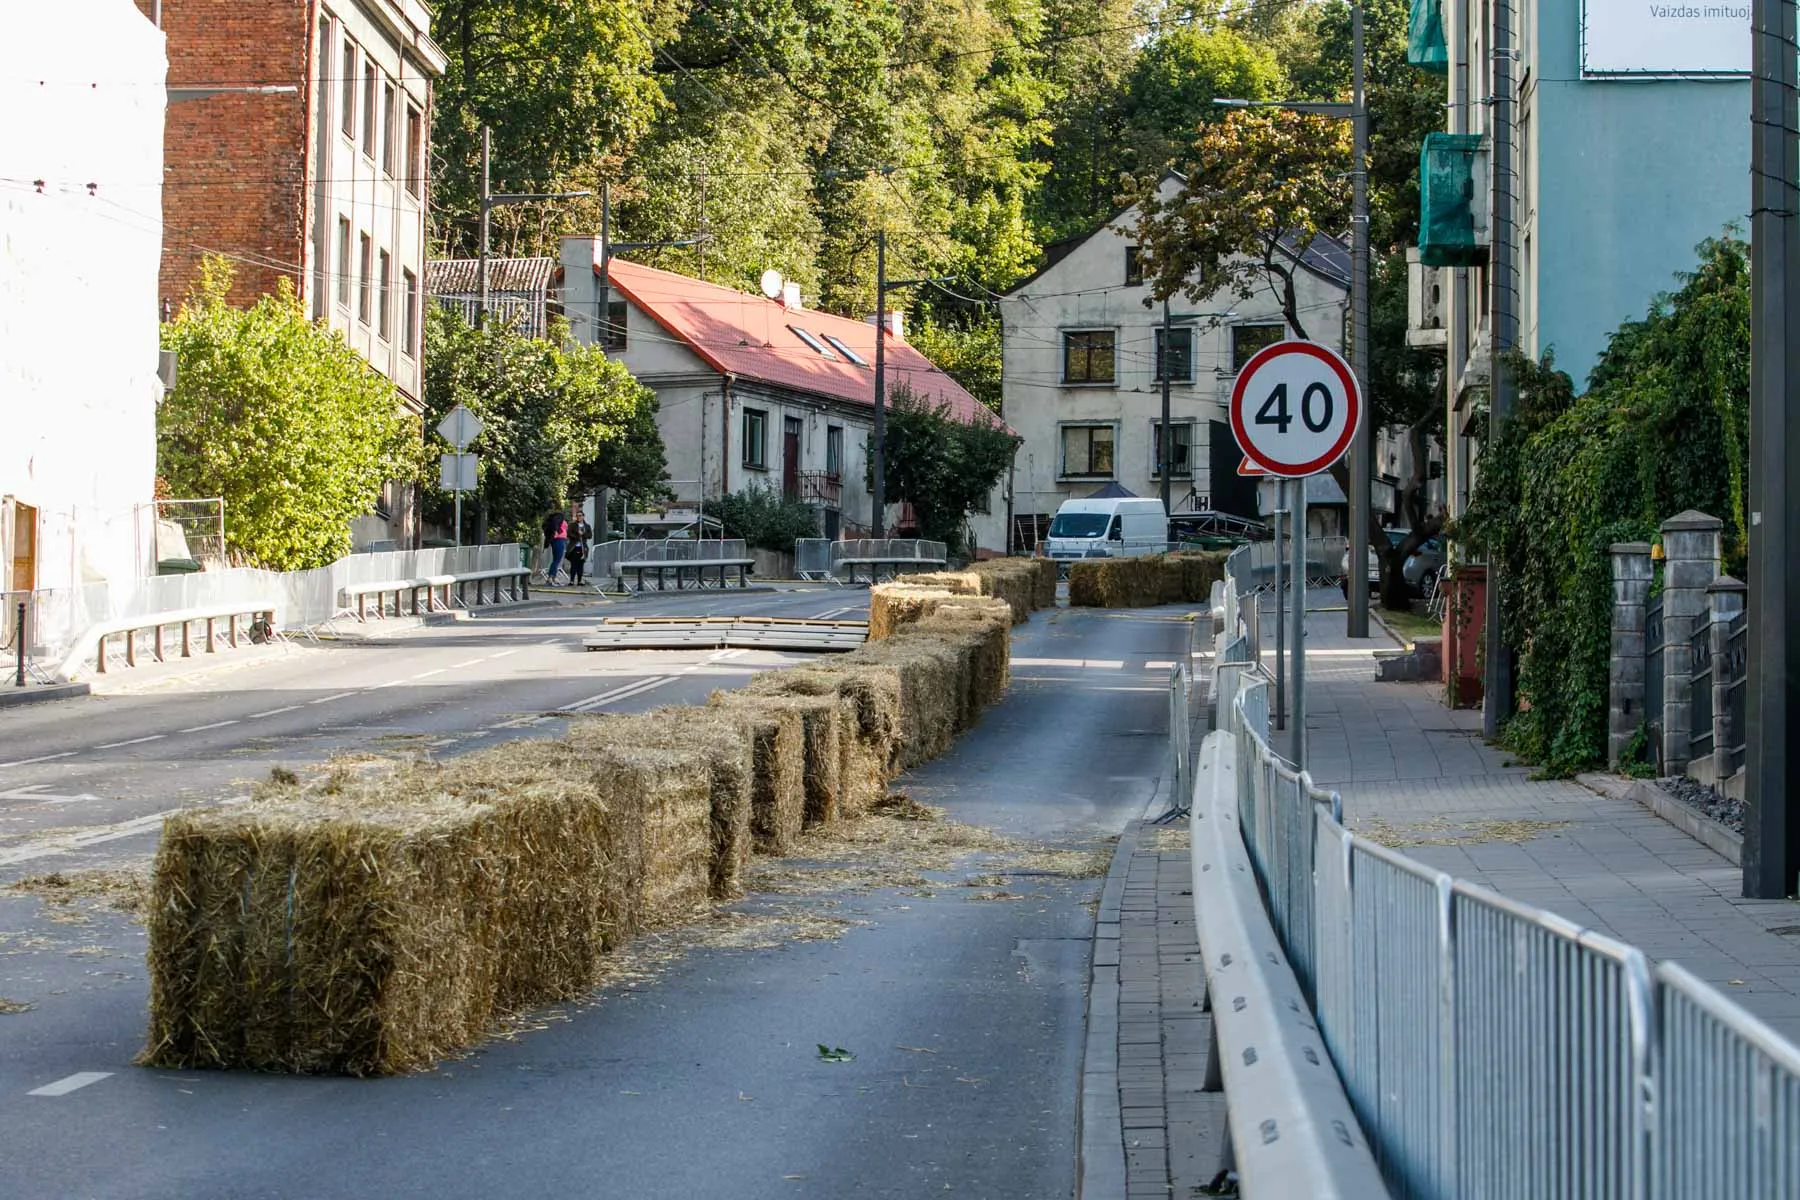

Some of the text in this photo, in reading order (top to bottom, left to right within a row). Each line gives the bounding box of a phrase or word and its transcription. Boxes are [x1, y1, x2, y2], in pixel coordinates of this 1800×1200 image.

[1650, 4, 1752, 20] Vaizdas imituoj
[1255, 382, 1333, 433] 40
